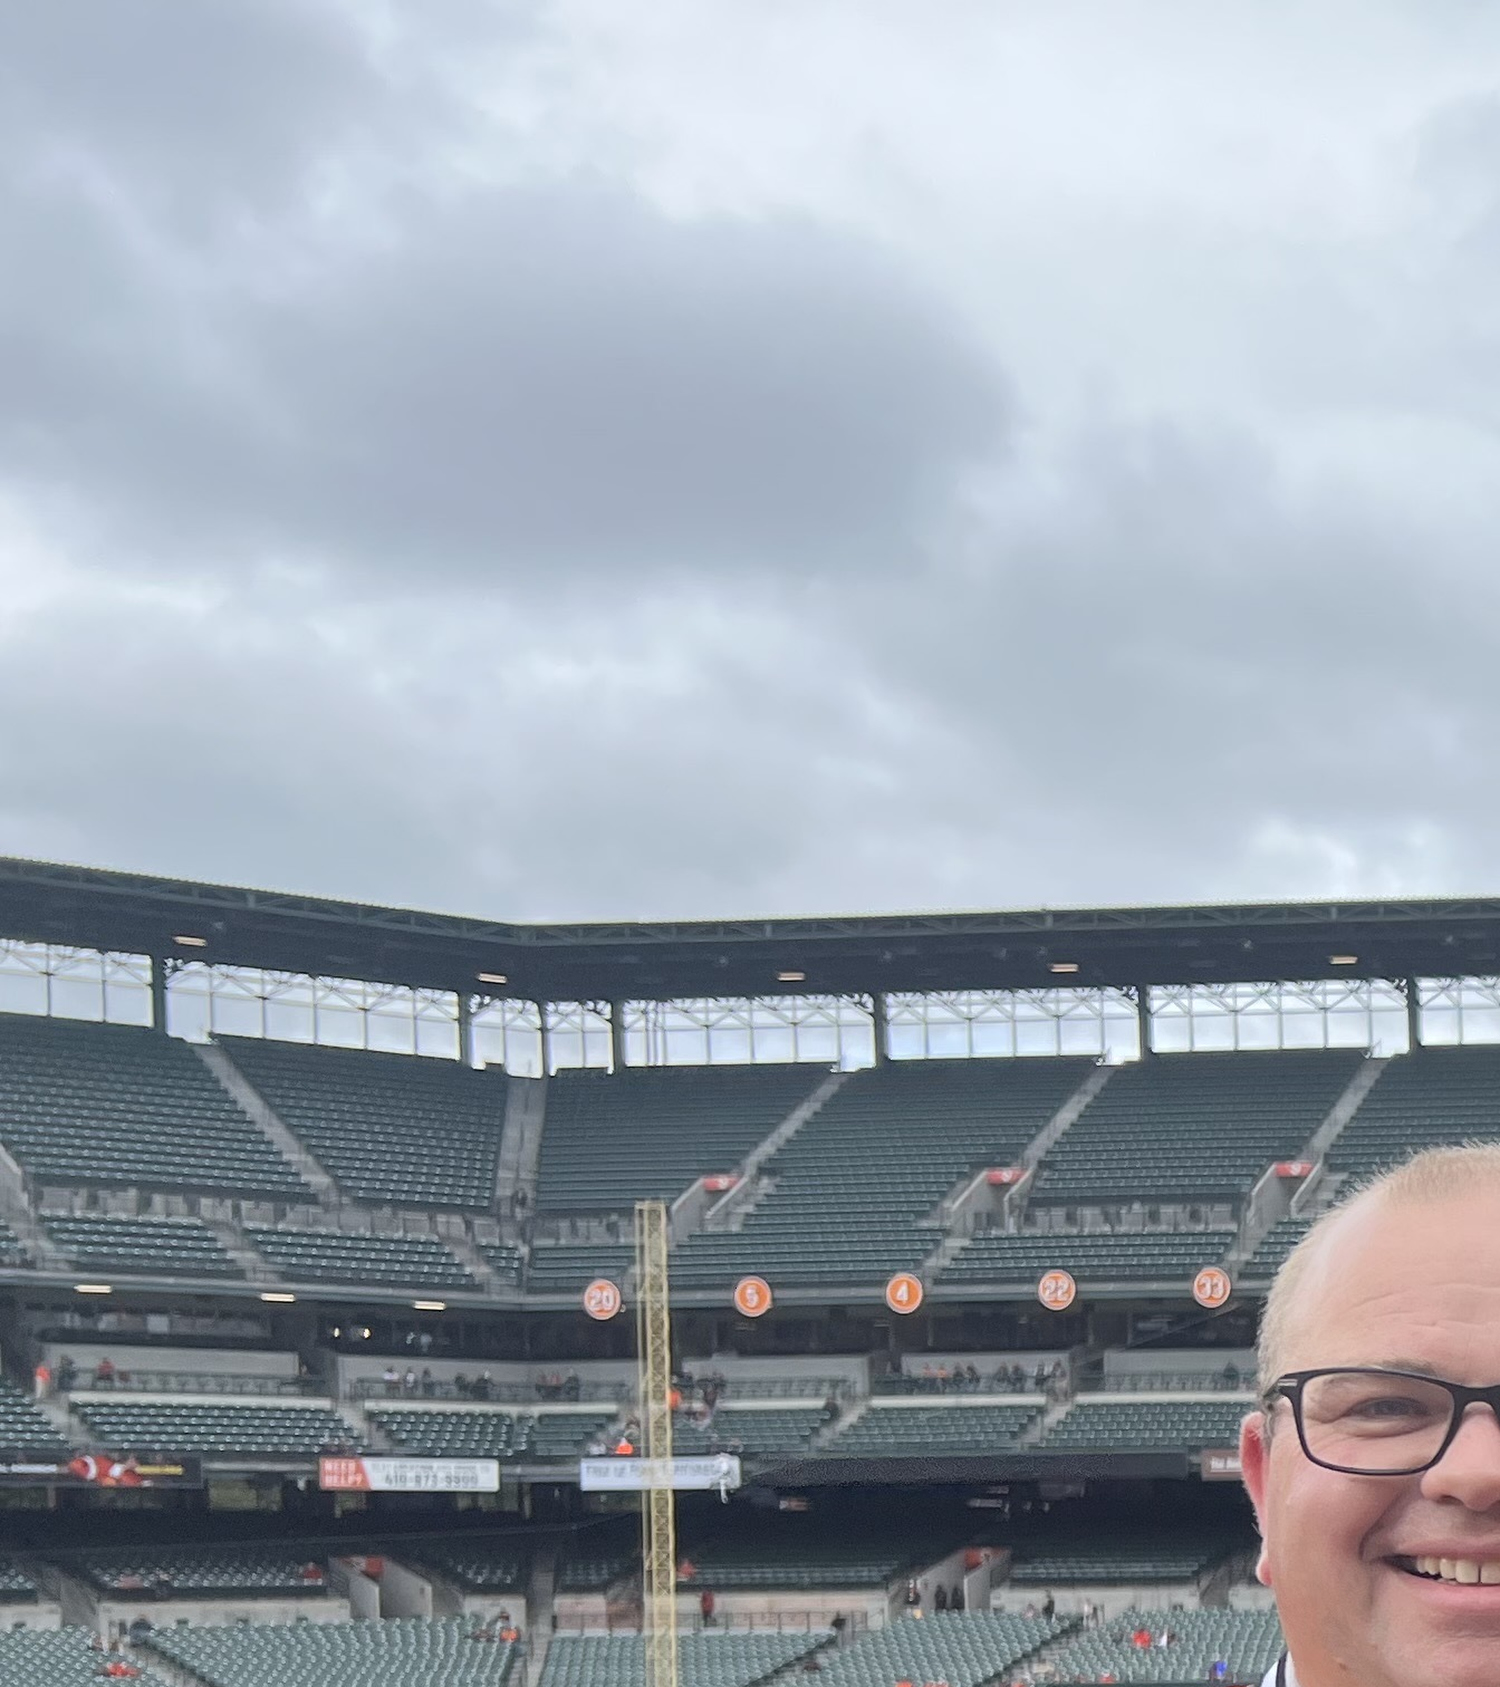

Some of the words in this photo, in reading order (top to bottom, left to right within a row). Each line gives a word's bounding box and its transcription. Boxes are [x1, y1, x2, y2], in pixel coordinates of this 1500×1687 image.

[744, 1286, 758, 1307] 5
[896, 1284, 910, 1305] 4
[1043, 1280, 1070, 1301] 22
[1202, 1276, 1225, 1299] 33
[591, 1290, 614, 1311] 20
